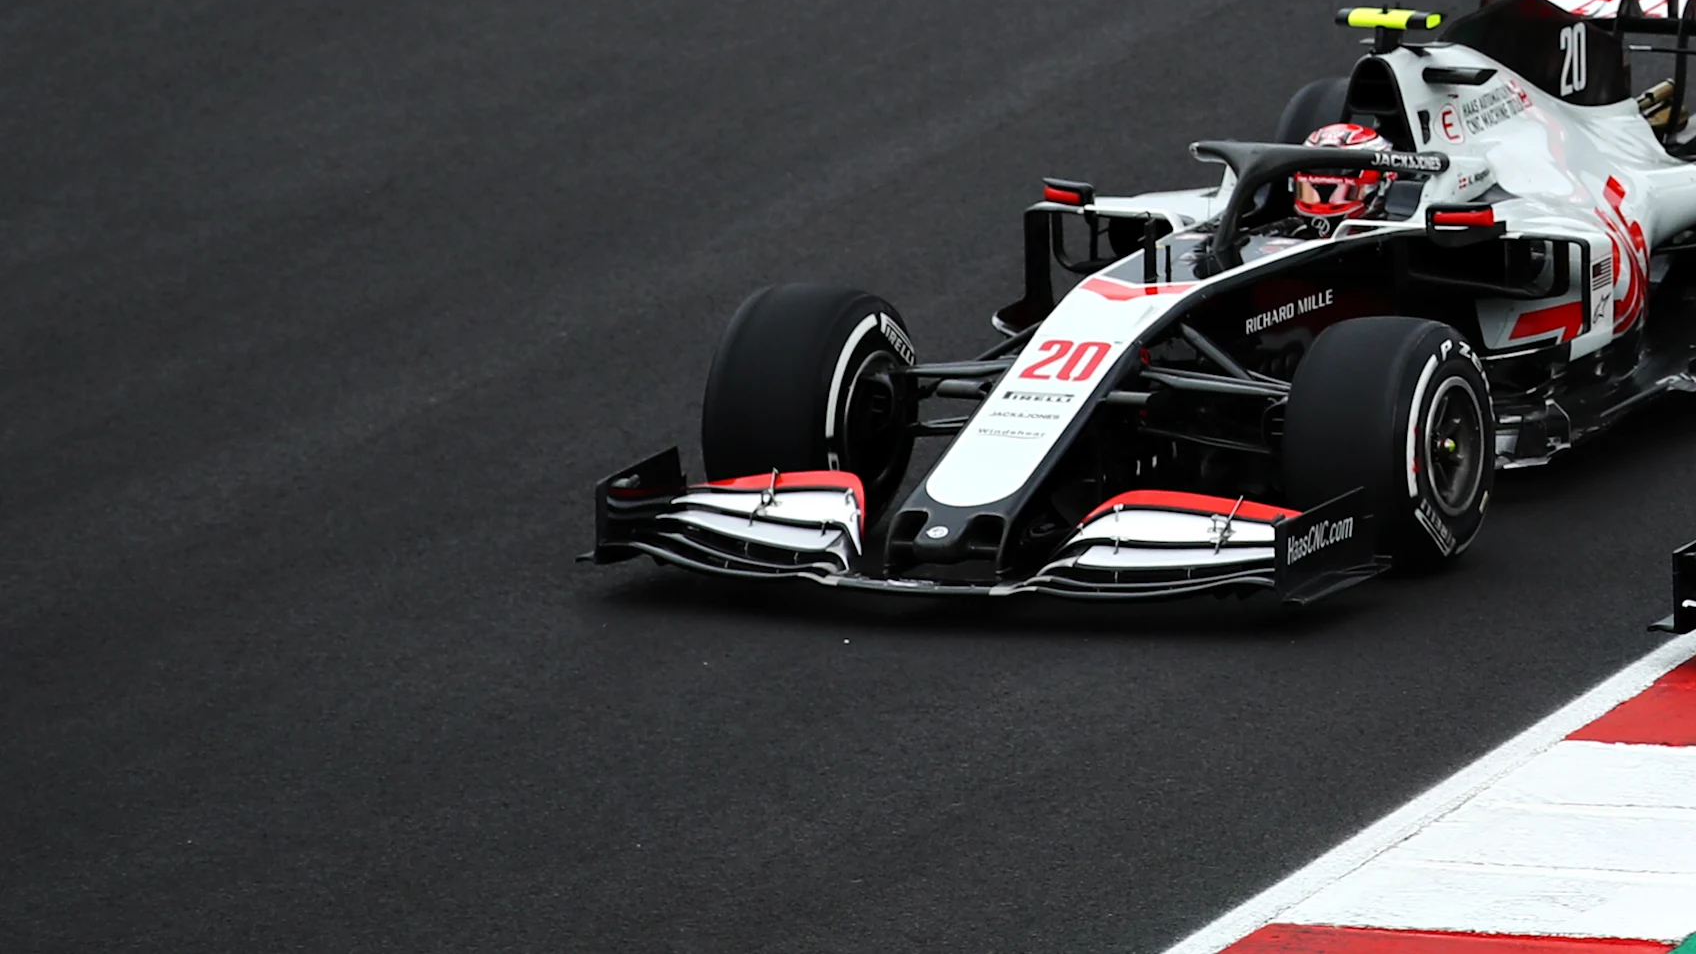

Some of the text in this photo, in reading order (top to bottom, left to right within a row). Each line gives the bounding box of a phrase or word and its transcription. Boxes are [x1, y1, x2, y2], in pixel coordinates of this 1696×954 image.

[1559, 21, 1587, 98] 20
[1441, 109, 1461, 141] E
[1370, 152, 1443, 171] JACK&JONES
[1245, 288, 1334, 335] RICHARD MILLE
[879, 311, 916, 367] PIRELLI
[1018, 339, 1113, 382] 20
[989, 411, 1061, 420] JACK&JONES
[1001, 391, 1075, 403] PIRELLI
[1286, 515, 1354, 566] HaasCNC.com
